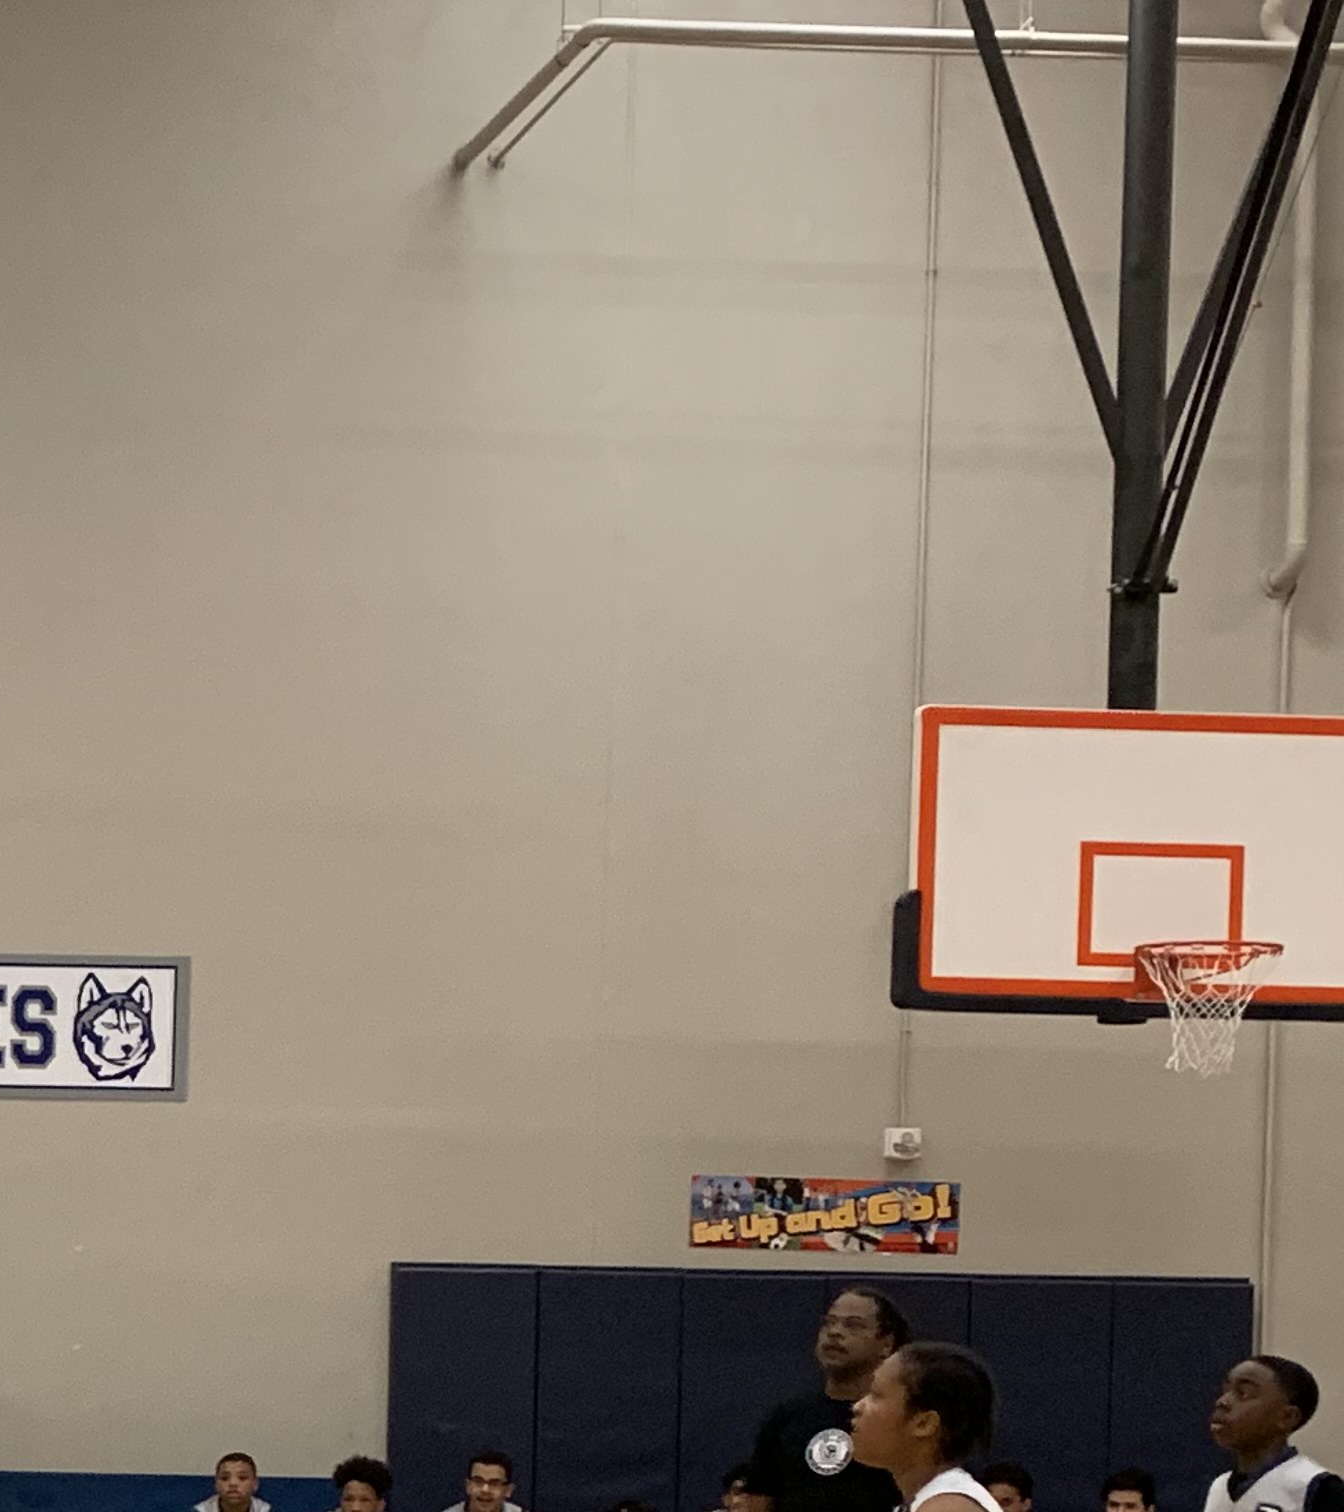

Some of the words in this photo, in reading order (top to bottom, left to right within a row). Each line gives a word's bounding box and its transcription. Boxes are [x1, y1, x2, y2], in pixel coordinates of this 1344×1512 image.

[692, 1218, 735, 1244] Get
[738, 1213, 779, 1244] Up
[785, 1199, 859, 1235] and
[867, 1183, 952, 1226] Go!
